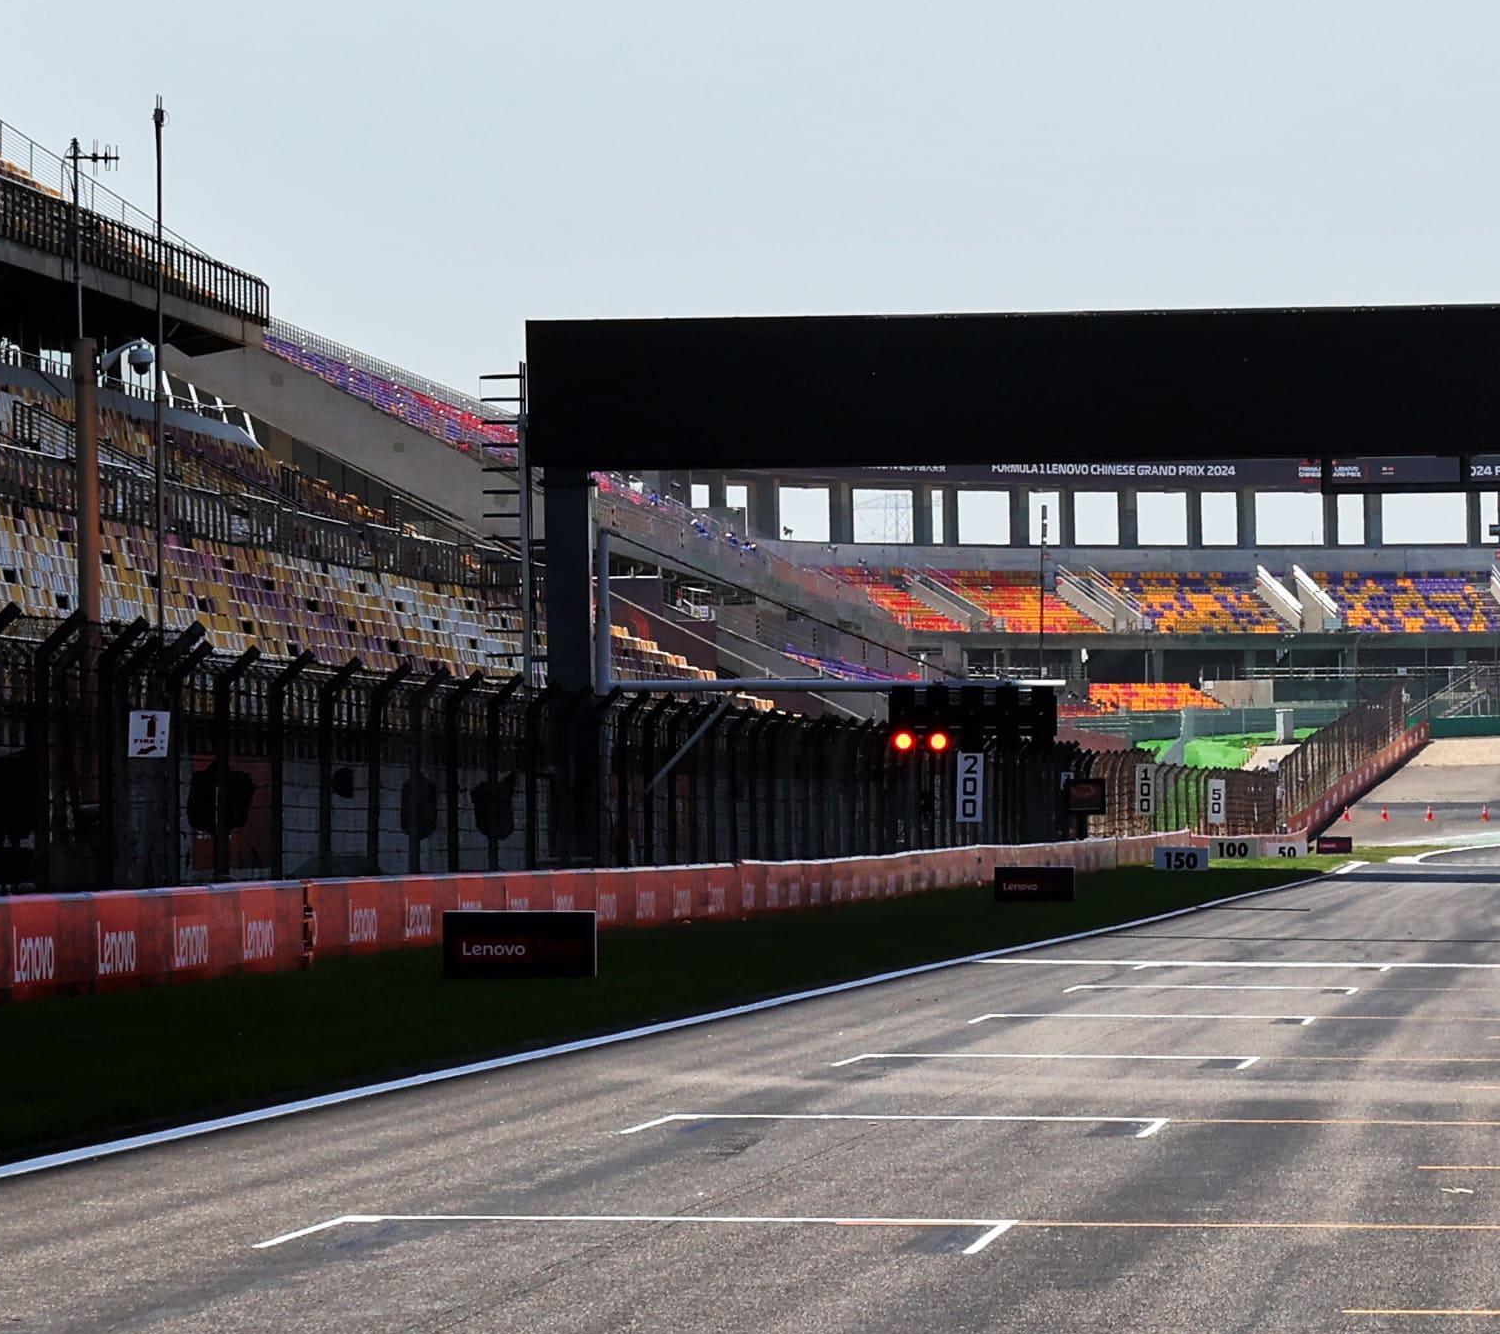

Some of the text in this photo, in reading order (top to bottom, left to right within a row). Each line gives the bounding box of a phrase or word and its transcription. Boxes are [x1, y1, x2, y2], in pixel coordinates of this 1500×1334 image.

[1046, 464, 1088, 475] LENOVO
[1090, 465, 1135, 476] CHINESE
[1137, 465, 1176, 476] GRAND
[1178, 466, 1205, 476] PRIX
[1207, 466, 1236, 476] 2024
[1471, 466, 1492, 476] 024
[961, 755, 979, 815] 200
[1139, 768, 1151, 813] 100
[1211, 787, 1223, 815] 50
[1217, 841, 1249, 858] 100
[1278, 846, 1297, 858] 50
[1164, 851, 1198, 870] 150
[1002, 883, 1038, 891] Lenovo
[13, 925, 55, 984] Lenovo
[96, 921, 136, 975] Lenovo
[462, 941, 526, 956] Lenovo
